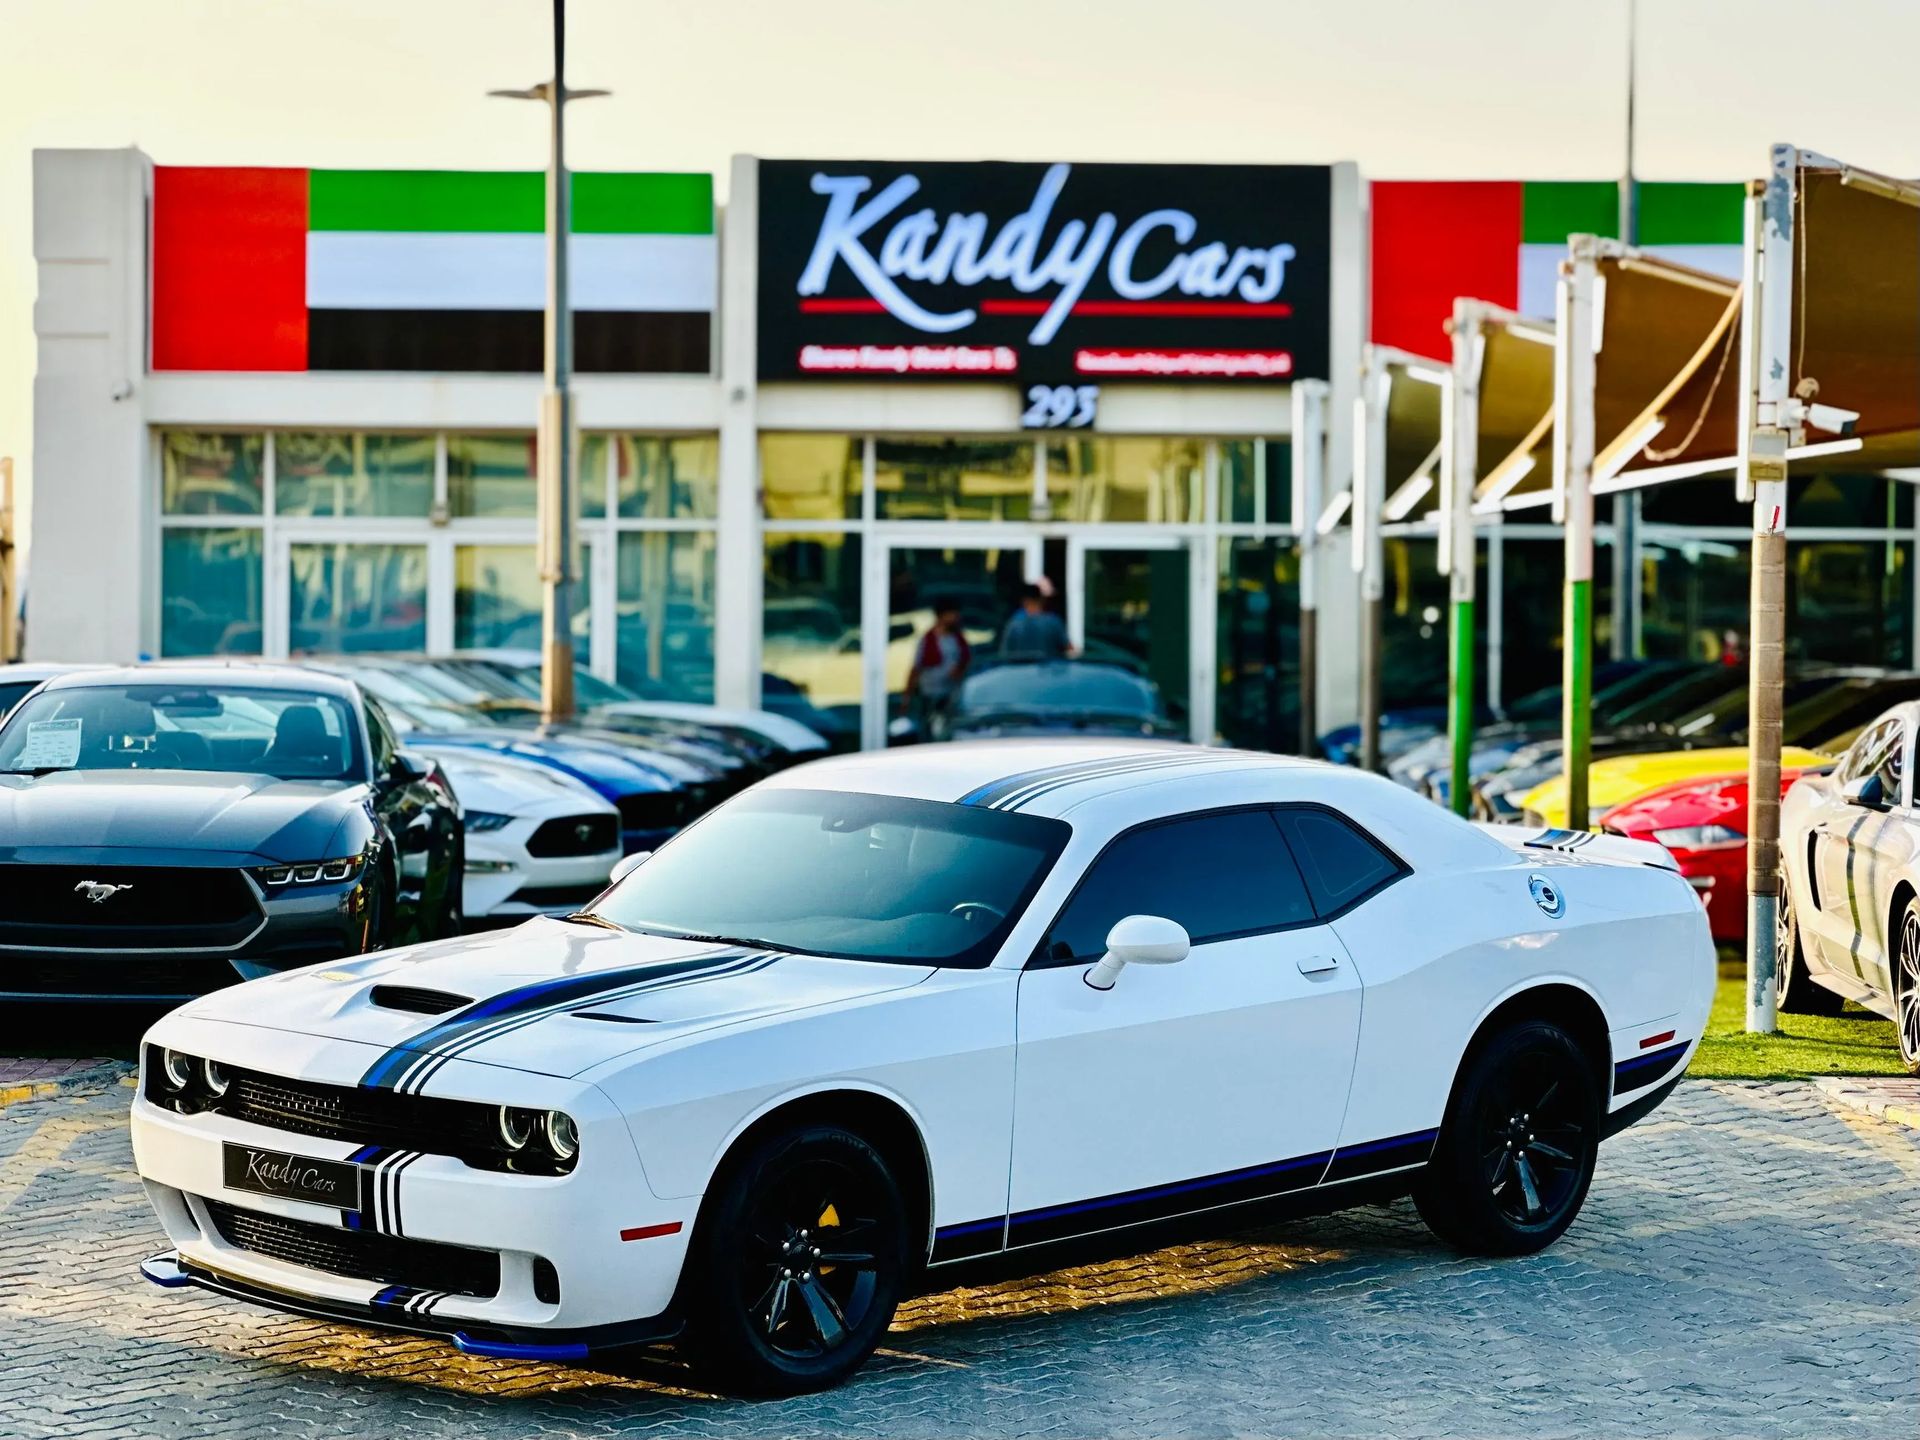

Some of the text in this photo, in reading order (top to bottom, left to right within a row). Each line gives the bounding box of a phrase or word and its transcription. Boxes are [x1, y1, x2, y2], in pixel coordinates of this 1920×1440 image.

[797, 162, 1296, 346] Kandy Cars
[245, 1150, 337, 1194] Kandy Cars
